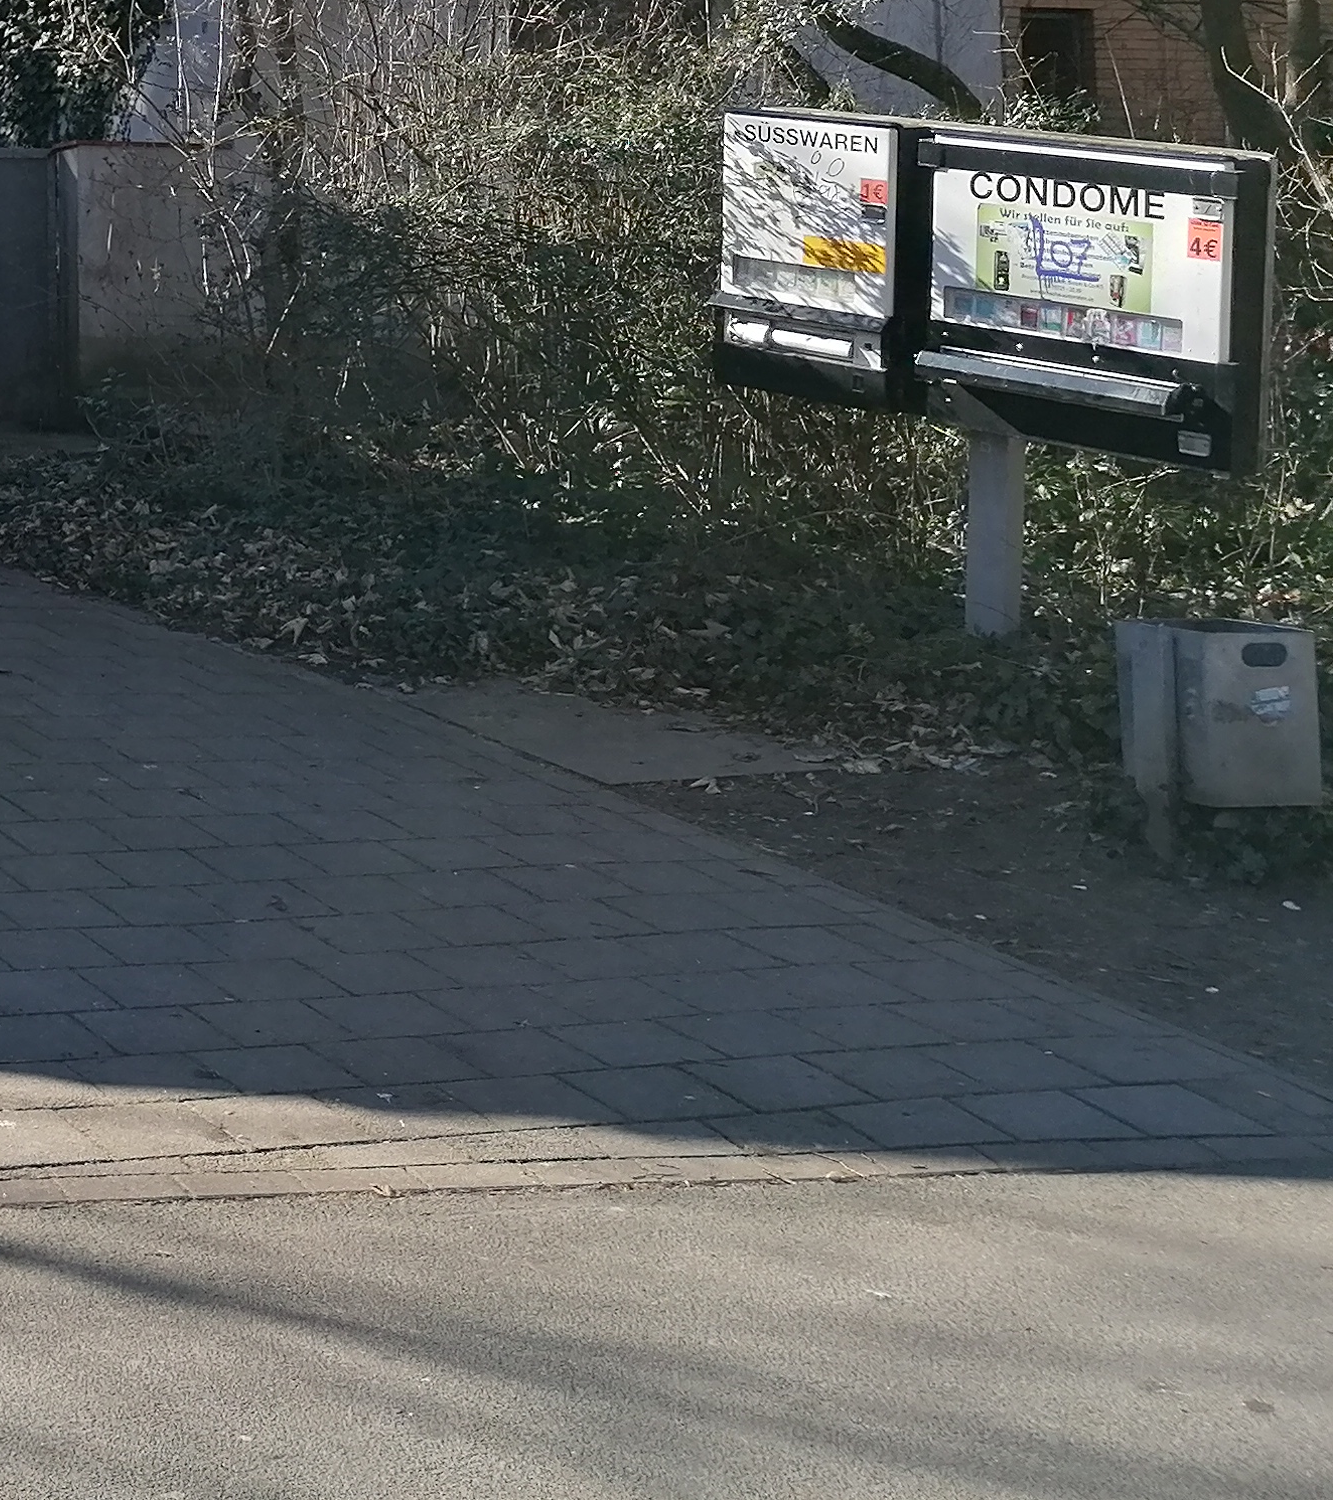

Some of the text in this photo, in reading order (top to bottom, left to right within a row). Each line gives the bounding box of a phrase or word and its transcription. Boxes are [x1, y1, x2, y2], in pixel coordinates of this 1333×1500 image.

[744, 121, 879, 154] SÜSSWAREN
[969, 171, 1166, 220] CONDOME
[999, 208, 1024, 219] Wir
[1064, 215, 1083, 227] für
[1085, 218, 1103, 230] Sie
[1104, 222, 1130, 233] auf:
[1189, 237, 1218, 258] 4€
